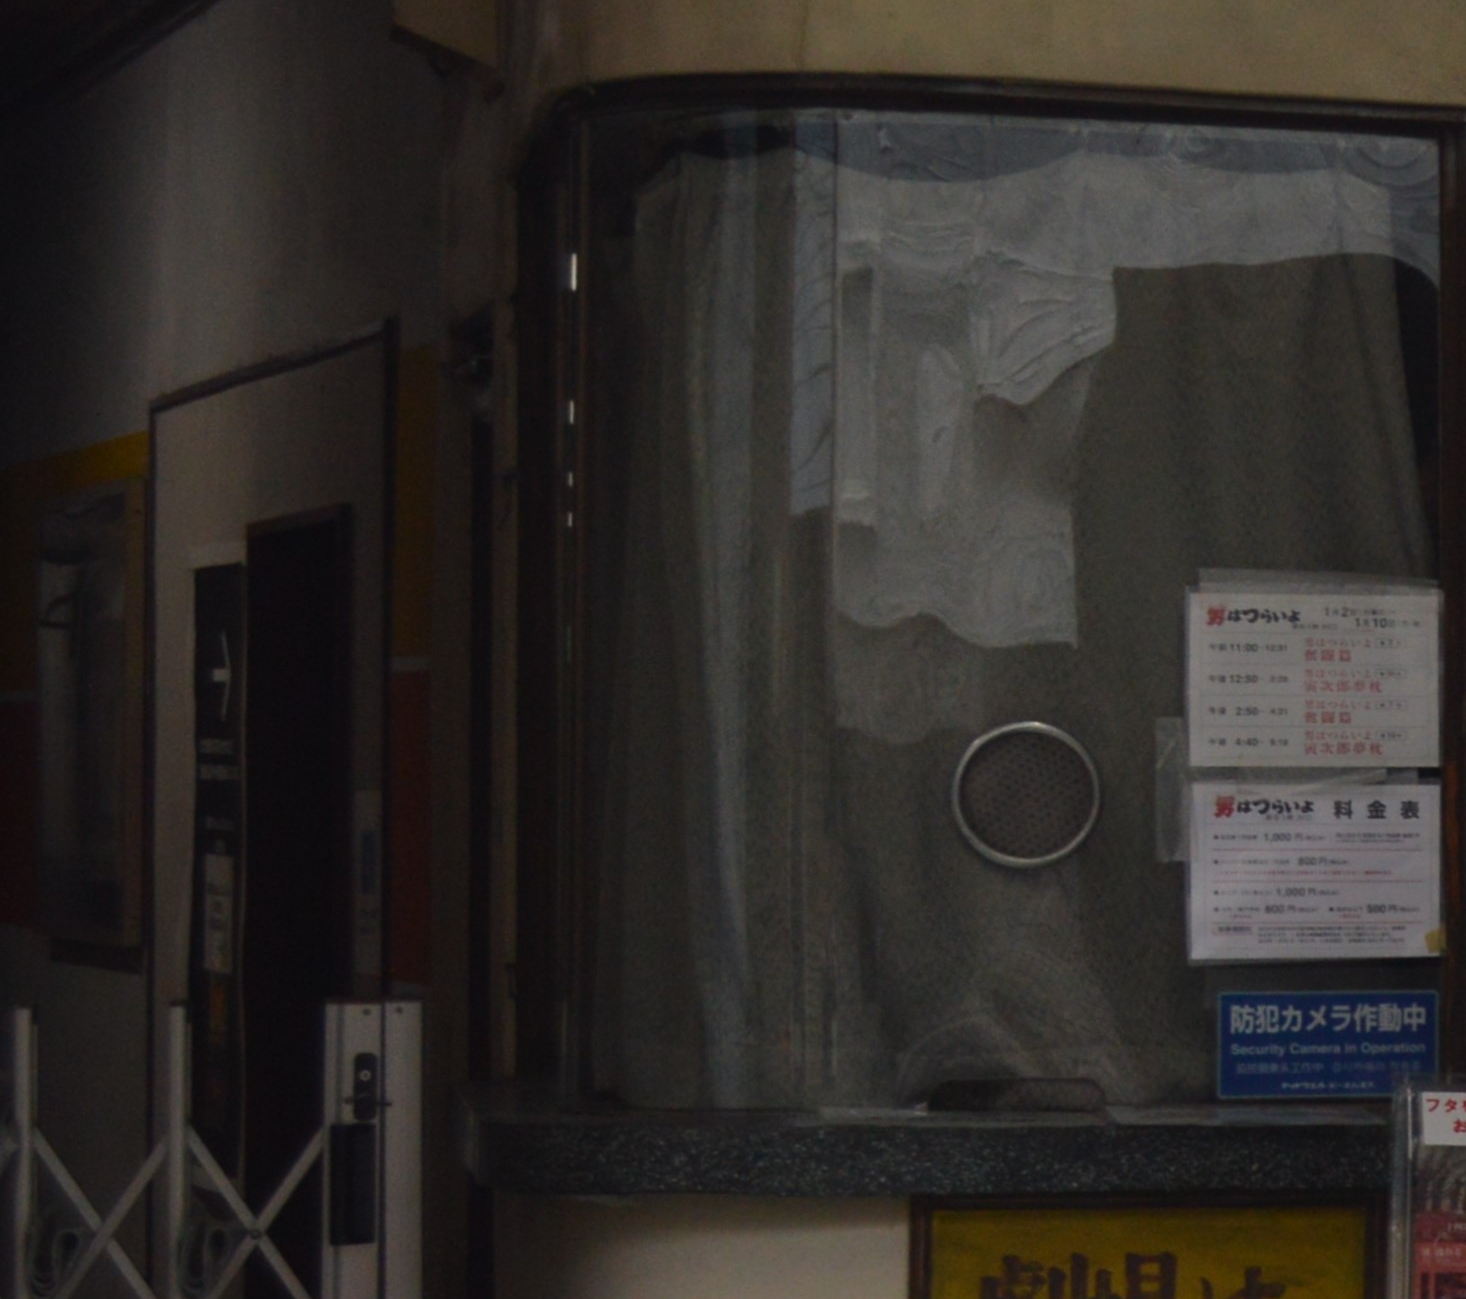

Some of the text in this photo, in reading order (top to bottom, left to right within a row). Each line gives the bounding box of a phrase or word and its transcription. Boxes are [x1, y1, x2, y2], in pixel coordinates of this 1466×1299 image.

[1229, 1003, 1428, 1035] 防犯カメラ作動中
[1230, 1043, 1286, 1057] Security
[1289, 1043, 1342, 1056] Camera
[1360, 1041, 1427, 1056] Operation
